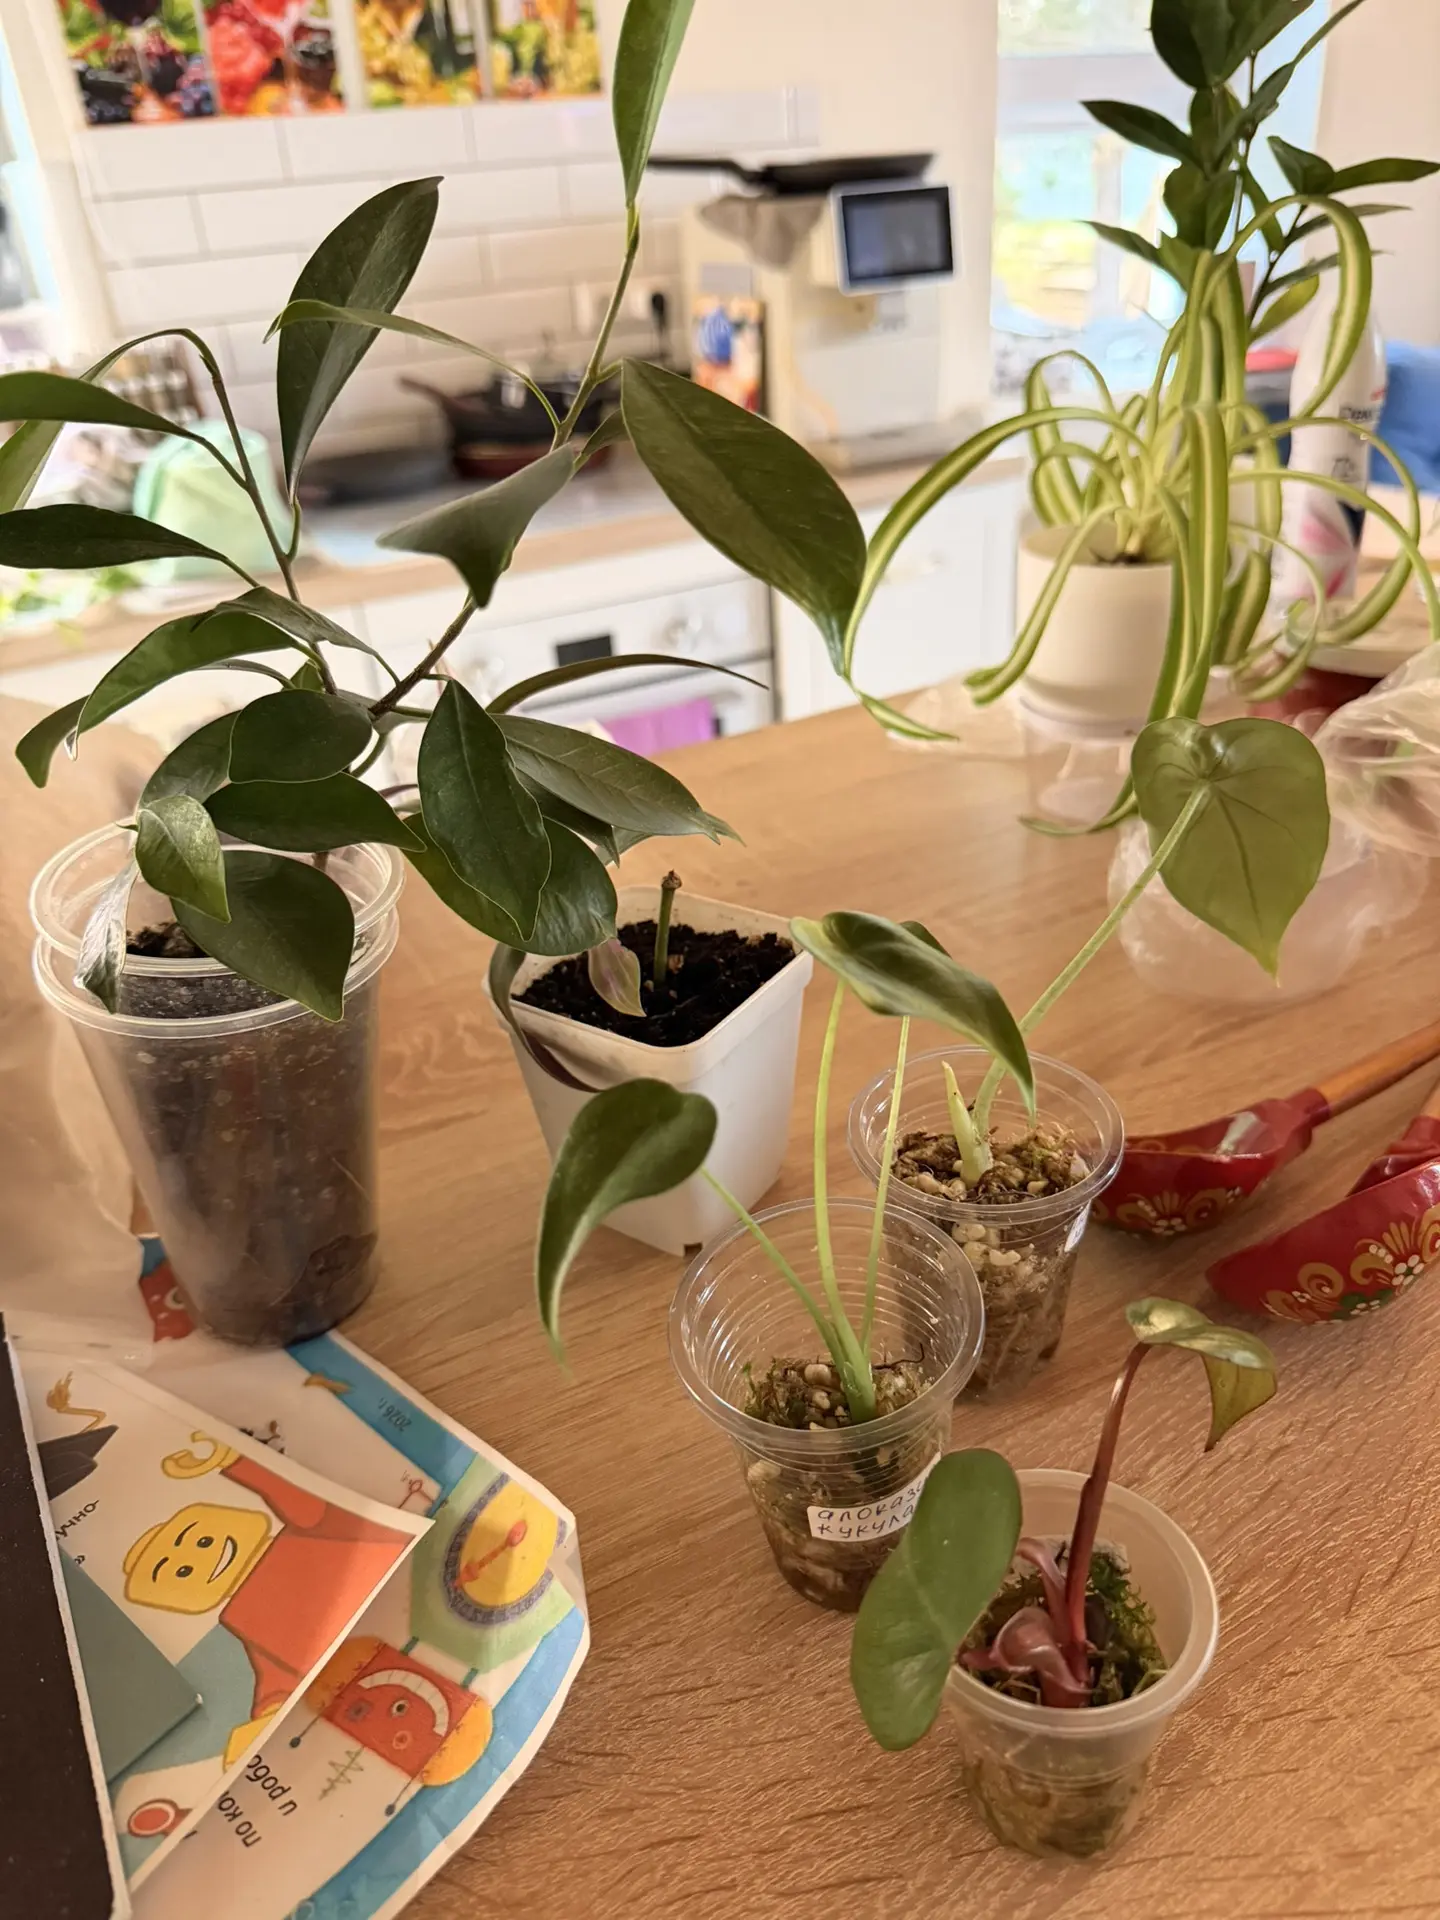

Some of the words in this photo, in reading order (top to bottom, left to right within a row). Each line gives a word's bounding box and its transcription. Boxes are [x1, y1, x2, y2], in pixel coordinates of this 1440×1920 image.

[382, 1404, 412, 1432] 2026
[56, 1499, 99, 1540] учно-
[235, 1820, 262, 1848] по
